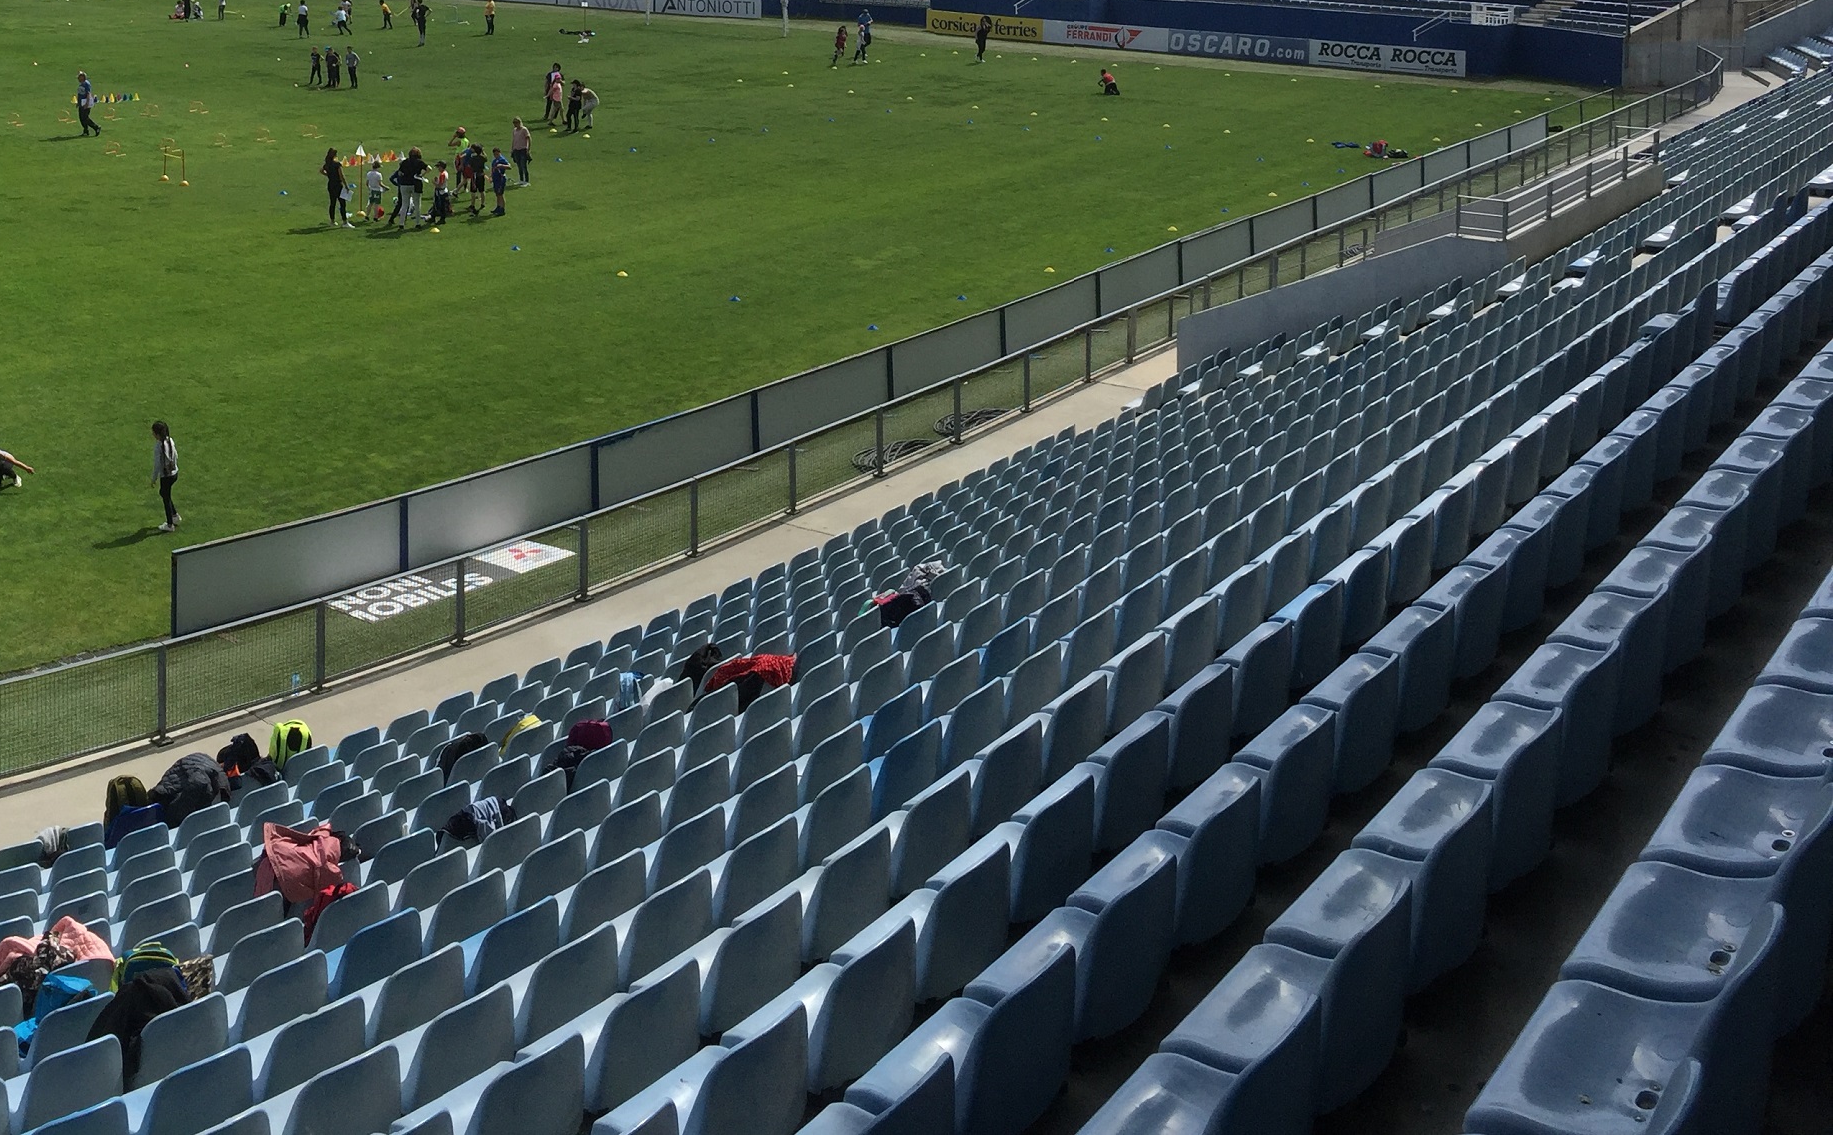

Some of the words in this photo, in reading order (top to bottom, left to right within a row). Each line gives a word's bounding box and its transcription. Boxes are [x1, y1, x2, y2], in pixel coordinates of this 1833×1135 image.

[931, 17, 977, 33] corsica
[993, 18, 1037, 38] ferries
[1067, 30, 1111, 42] FERRANDI
[1169, 33, 1305, 60] OSCARO.com
[1318, 42, 1381, 62] ROCCA
[1389, 48, 1457, 66] ROCCA
